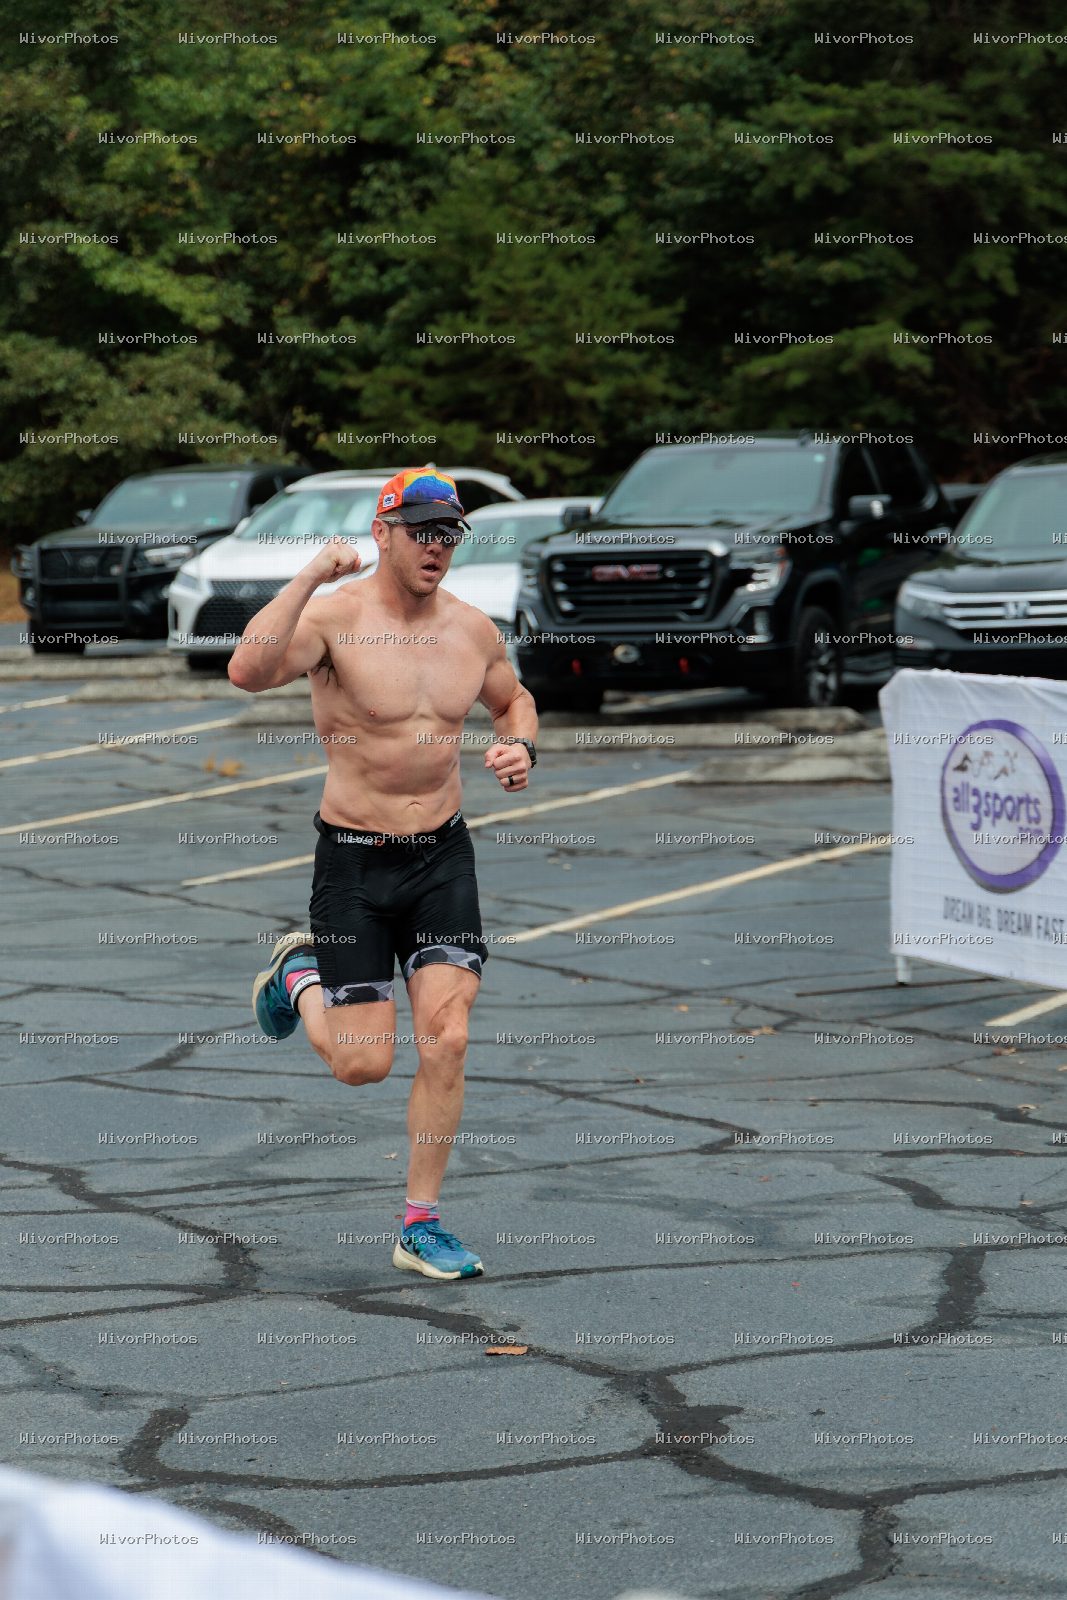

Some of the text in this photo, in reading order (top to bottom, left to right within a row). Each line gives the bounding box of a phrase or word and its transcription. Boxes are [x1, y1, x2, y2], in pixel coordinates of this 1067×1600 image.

[952, 781, 1041, 831] all3sports
[943, 896, 974, 924] DREAM
[997, 908, 1033, 938] DREAM
